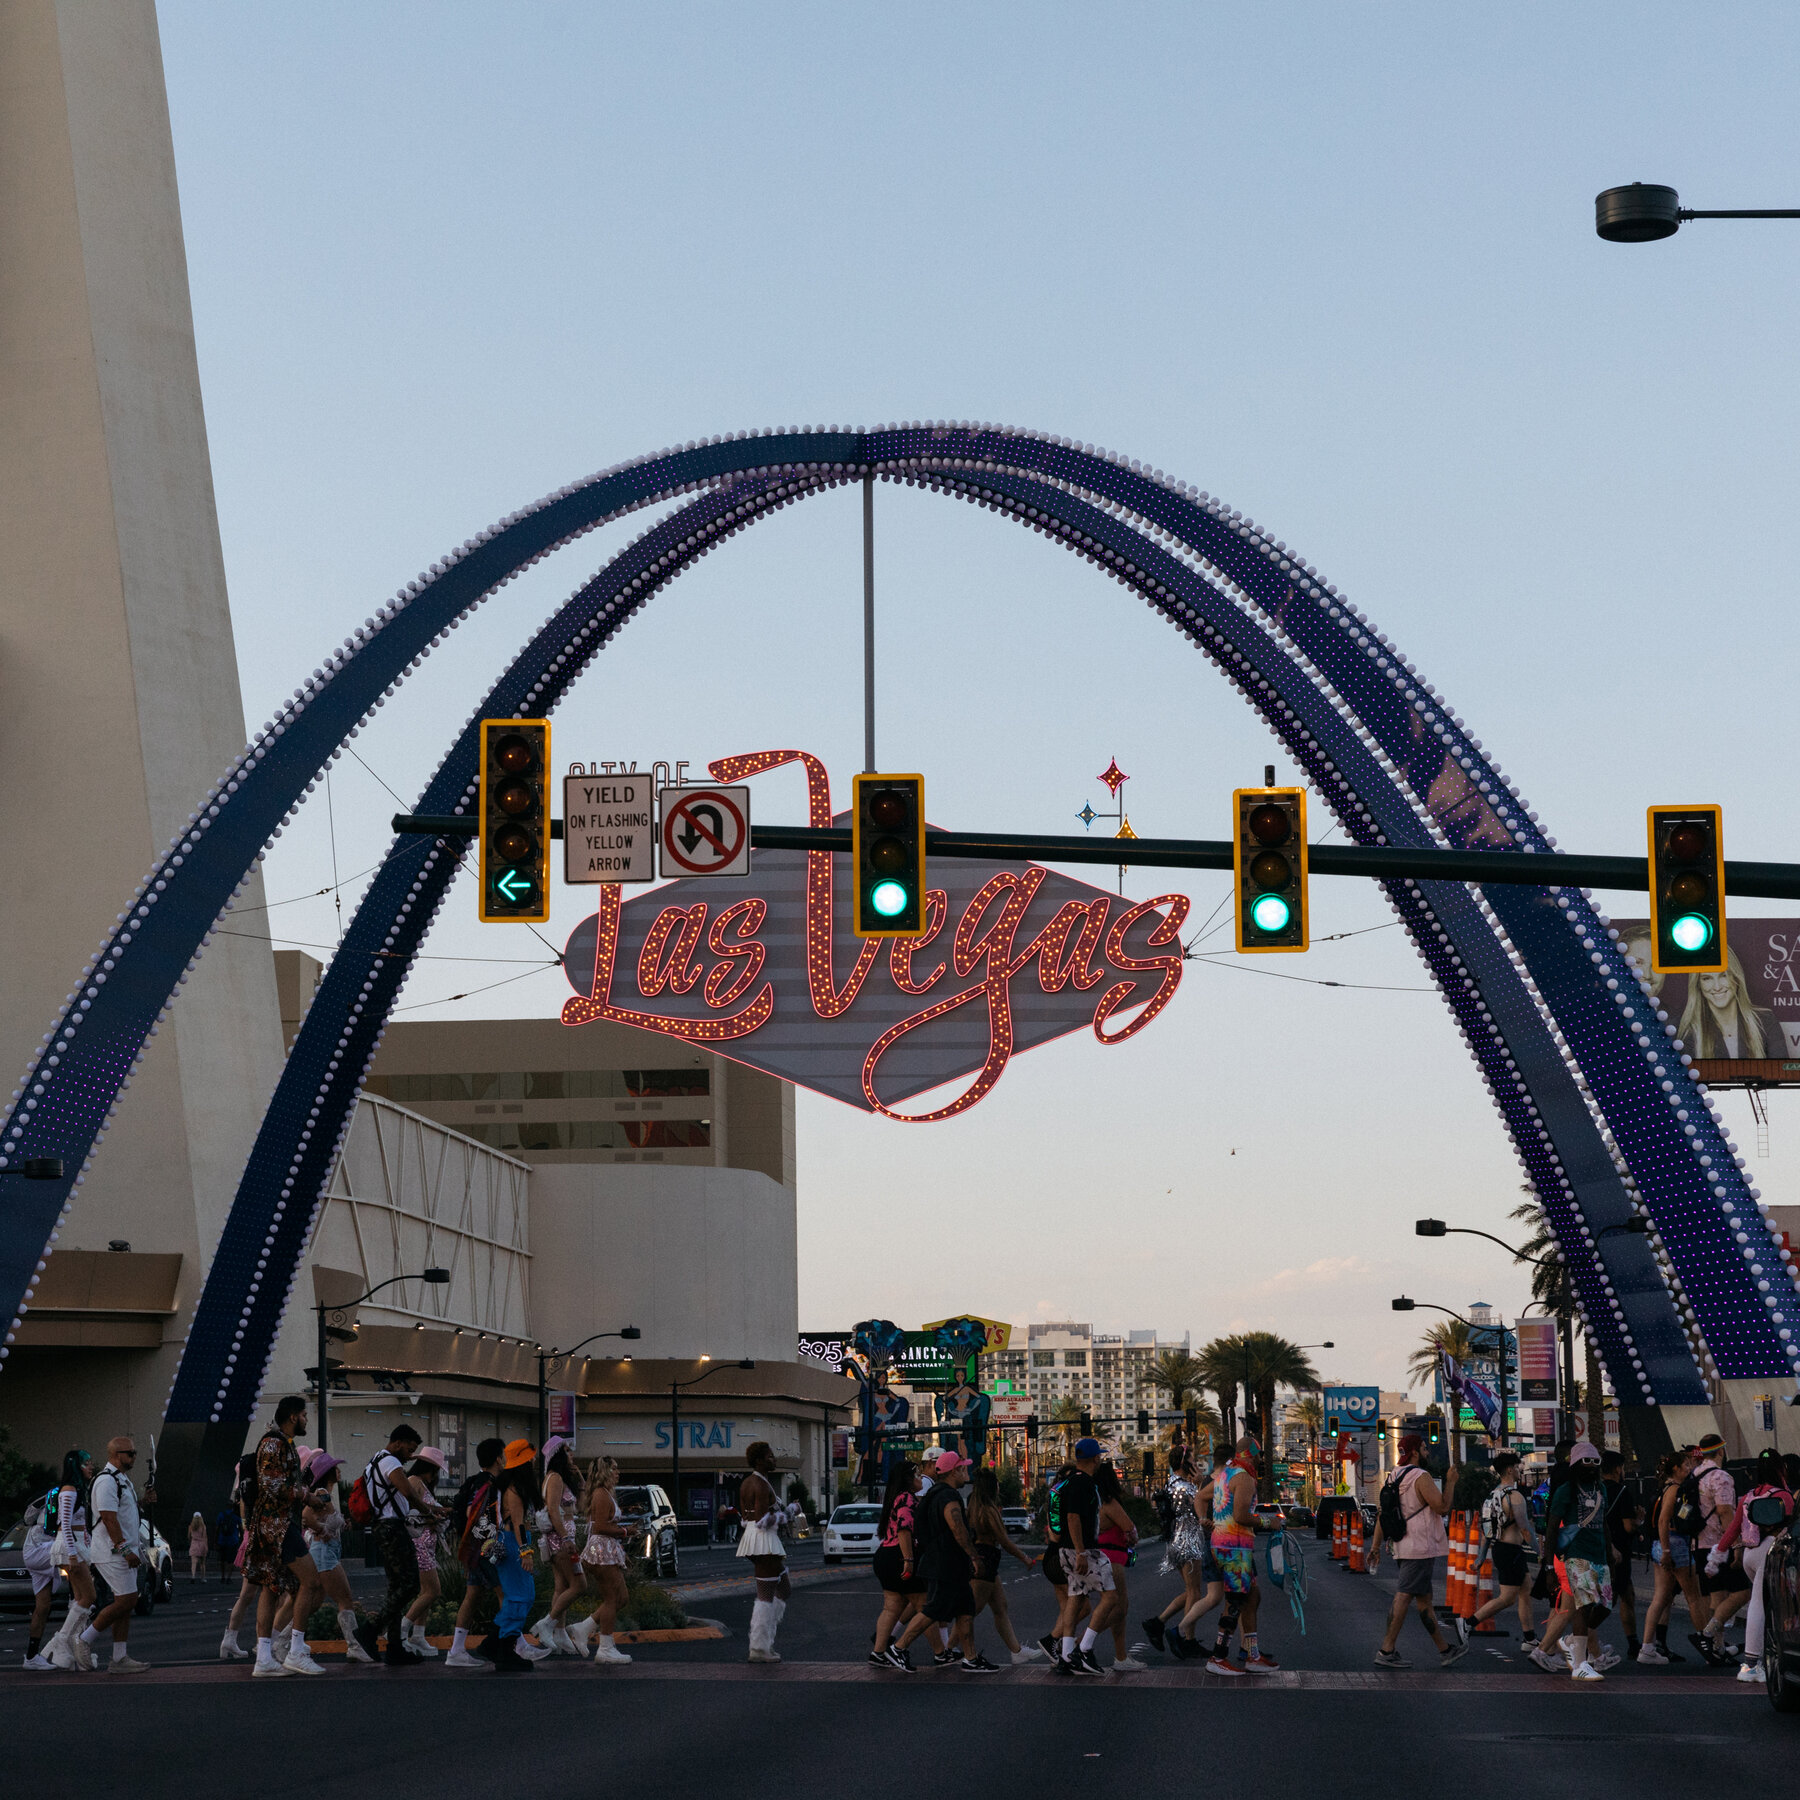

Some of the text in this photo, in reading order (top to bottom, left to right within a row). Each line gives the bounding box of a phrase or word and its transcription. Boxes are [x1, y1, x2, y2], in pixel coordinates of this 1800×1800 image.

[584, 787, 635, 804] YIELD
[570, 813, 649, 829] ON FLASHING
[586, 835, 634, 850] YELLOW
[588, 857, 631, 872] ARROW
[560, 748, 1191, 1123] Las Vegas
[1326, 1395, 1376, 1416] IHOP
[655, 1420, 737, 1449] STRAT
